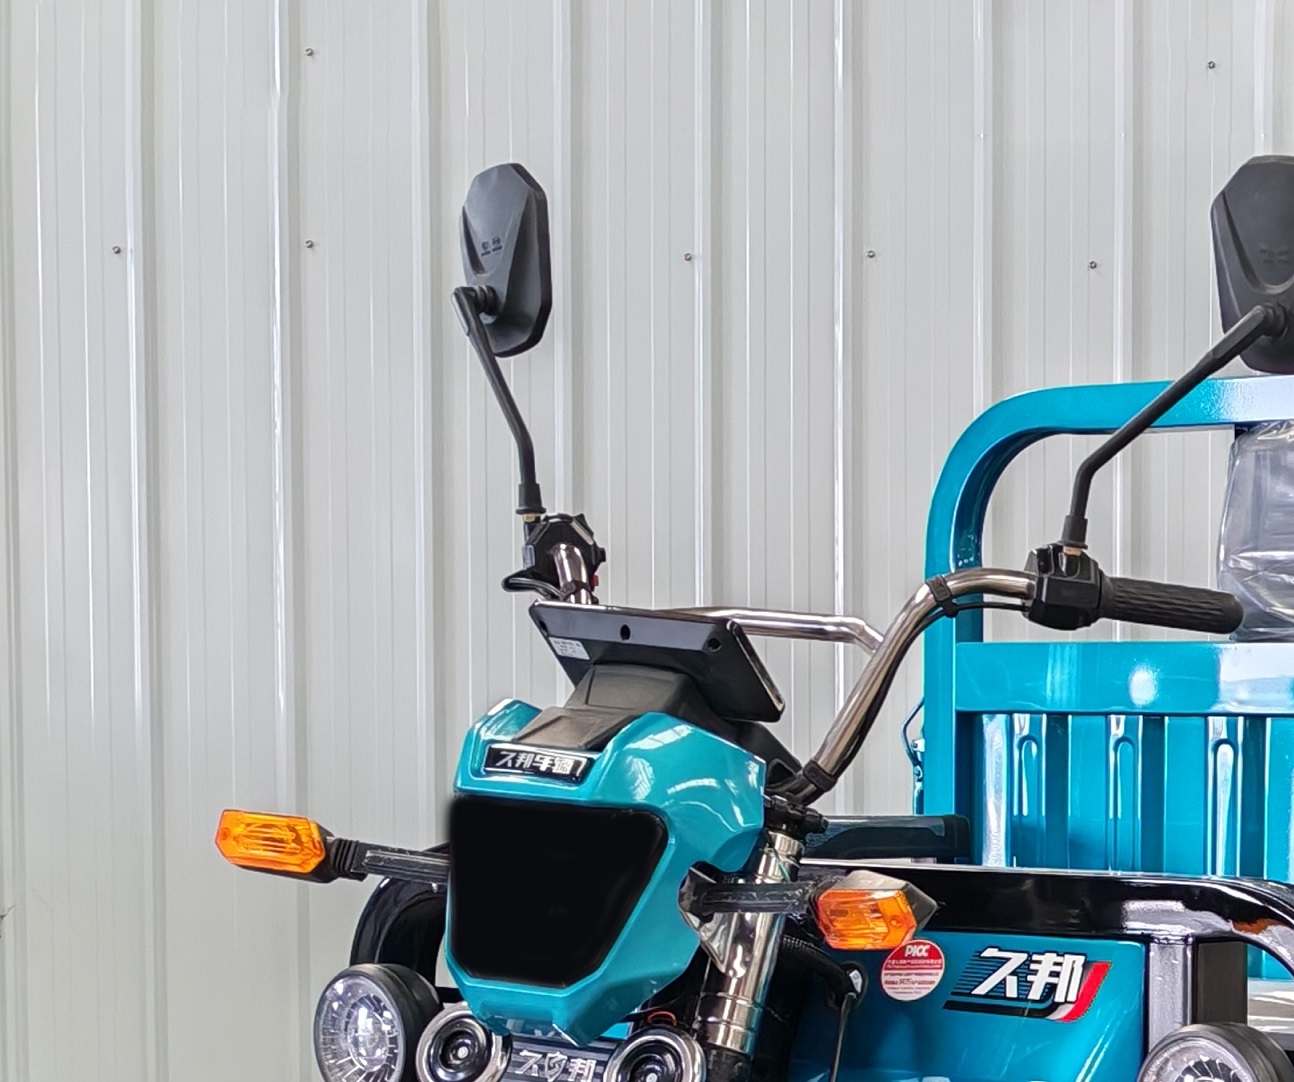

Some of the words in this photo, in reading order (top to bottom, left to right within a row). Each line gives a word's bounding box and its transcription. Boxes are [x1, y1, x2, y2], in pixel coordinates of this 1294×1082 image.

[495, 751, 574, 775] 久邦车辆
[904, 944, 931, 957] PICC
[971, 947, 1086, 1003] 久邦
